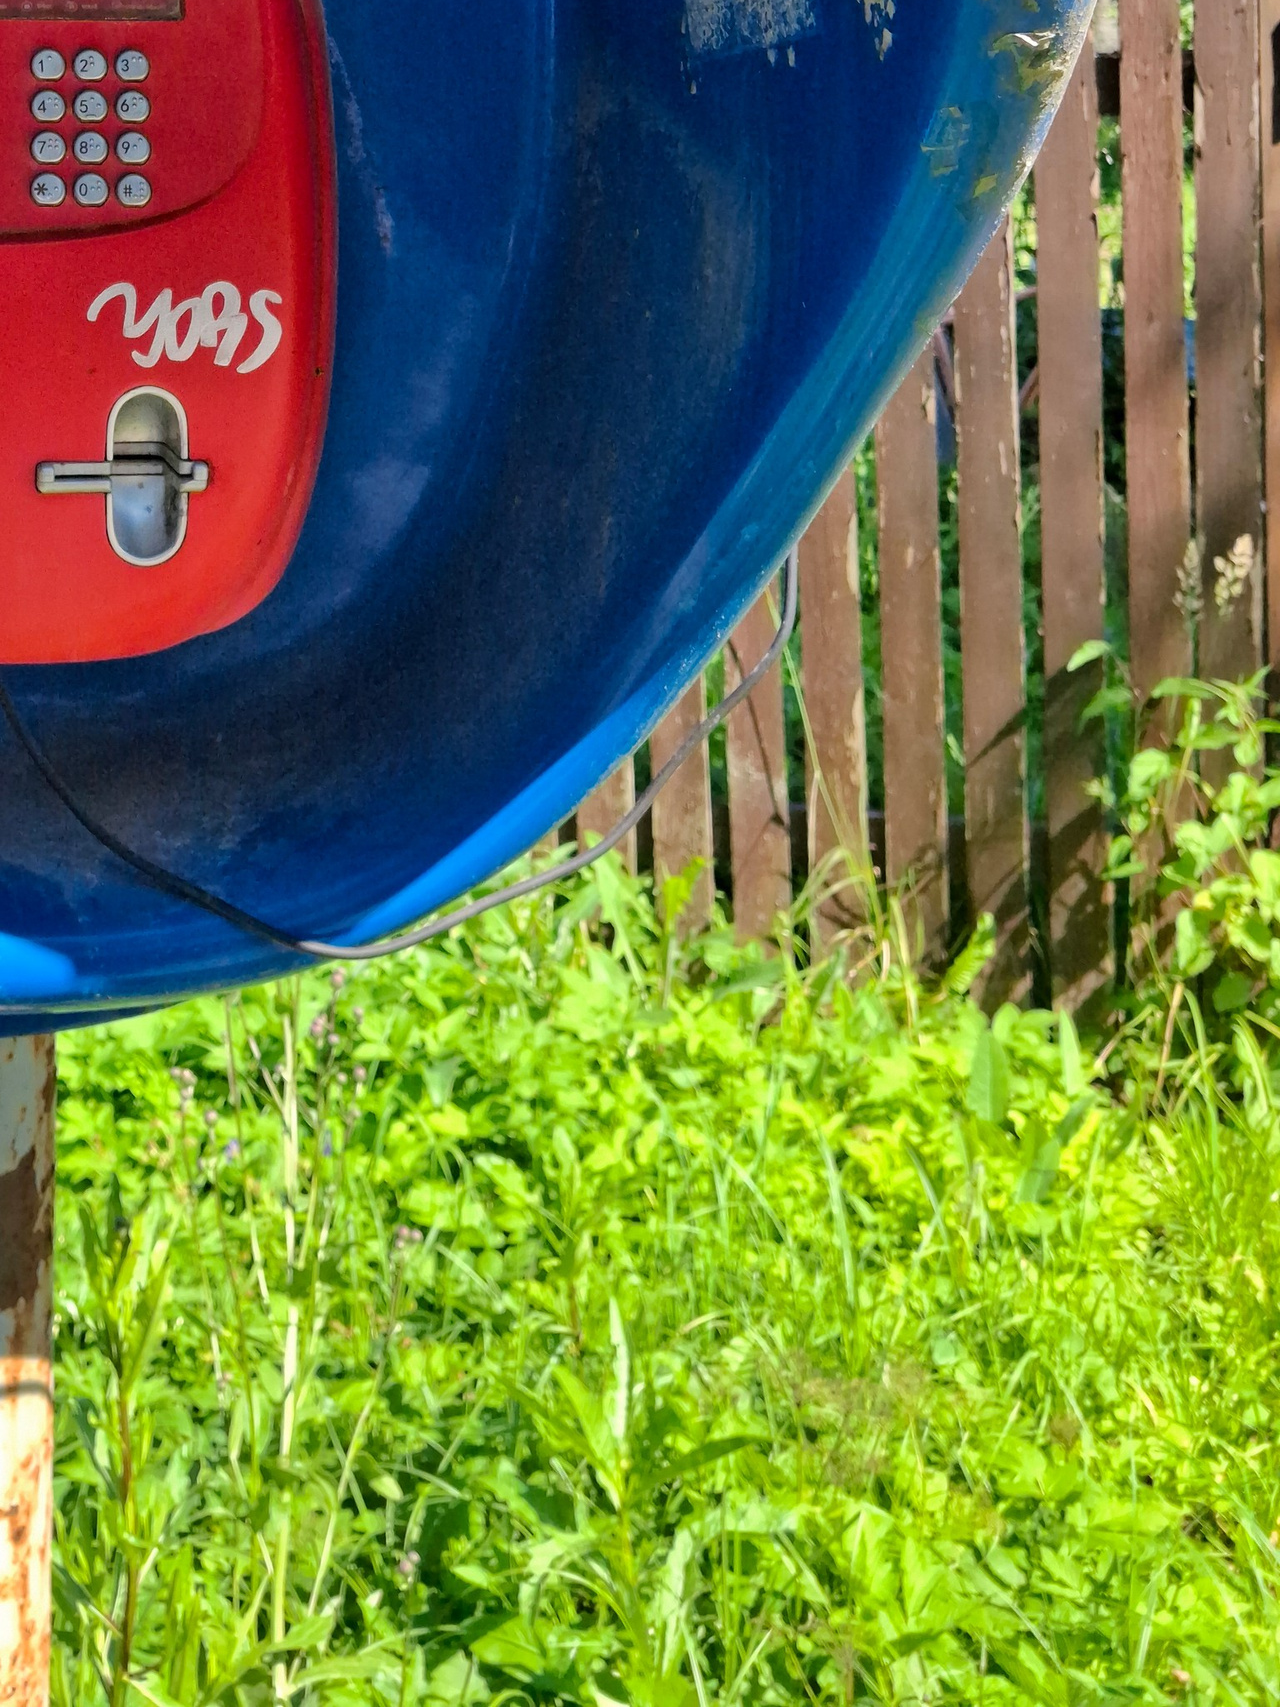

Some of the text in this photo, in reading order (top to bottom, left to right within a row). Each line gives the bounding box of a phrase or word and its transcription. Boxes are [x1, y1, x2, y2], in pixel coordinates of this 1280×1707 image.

[38, 59, 130, 73] 1 2 3
[37, 99, 129, 114] 4 5 6
[37, 140, 130, 155] 7 8 9
[79, 183, 88, 197] 0
